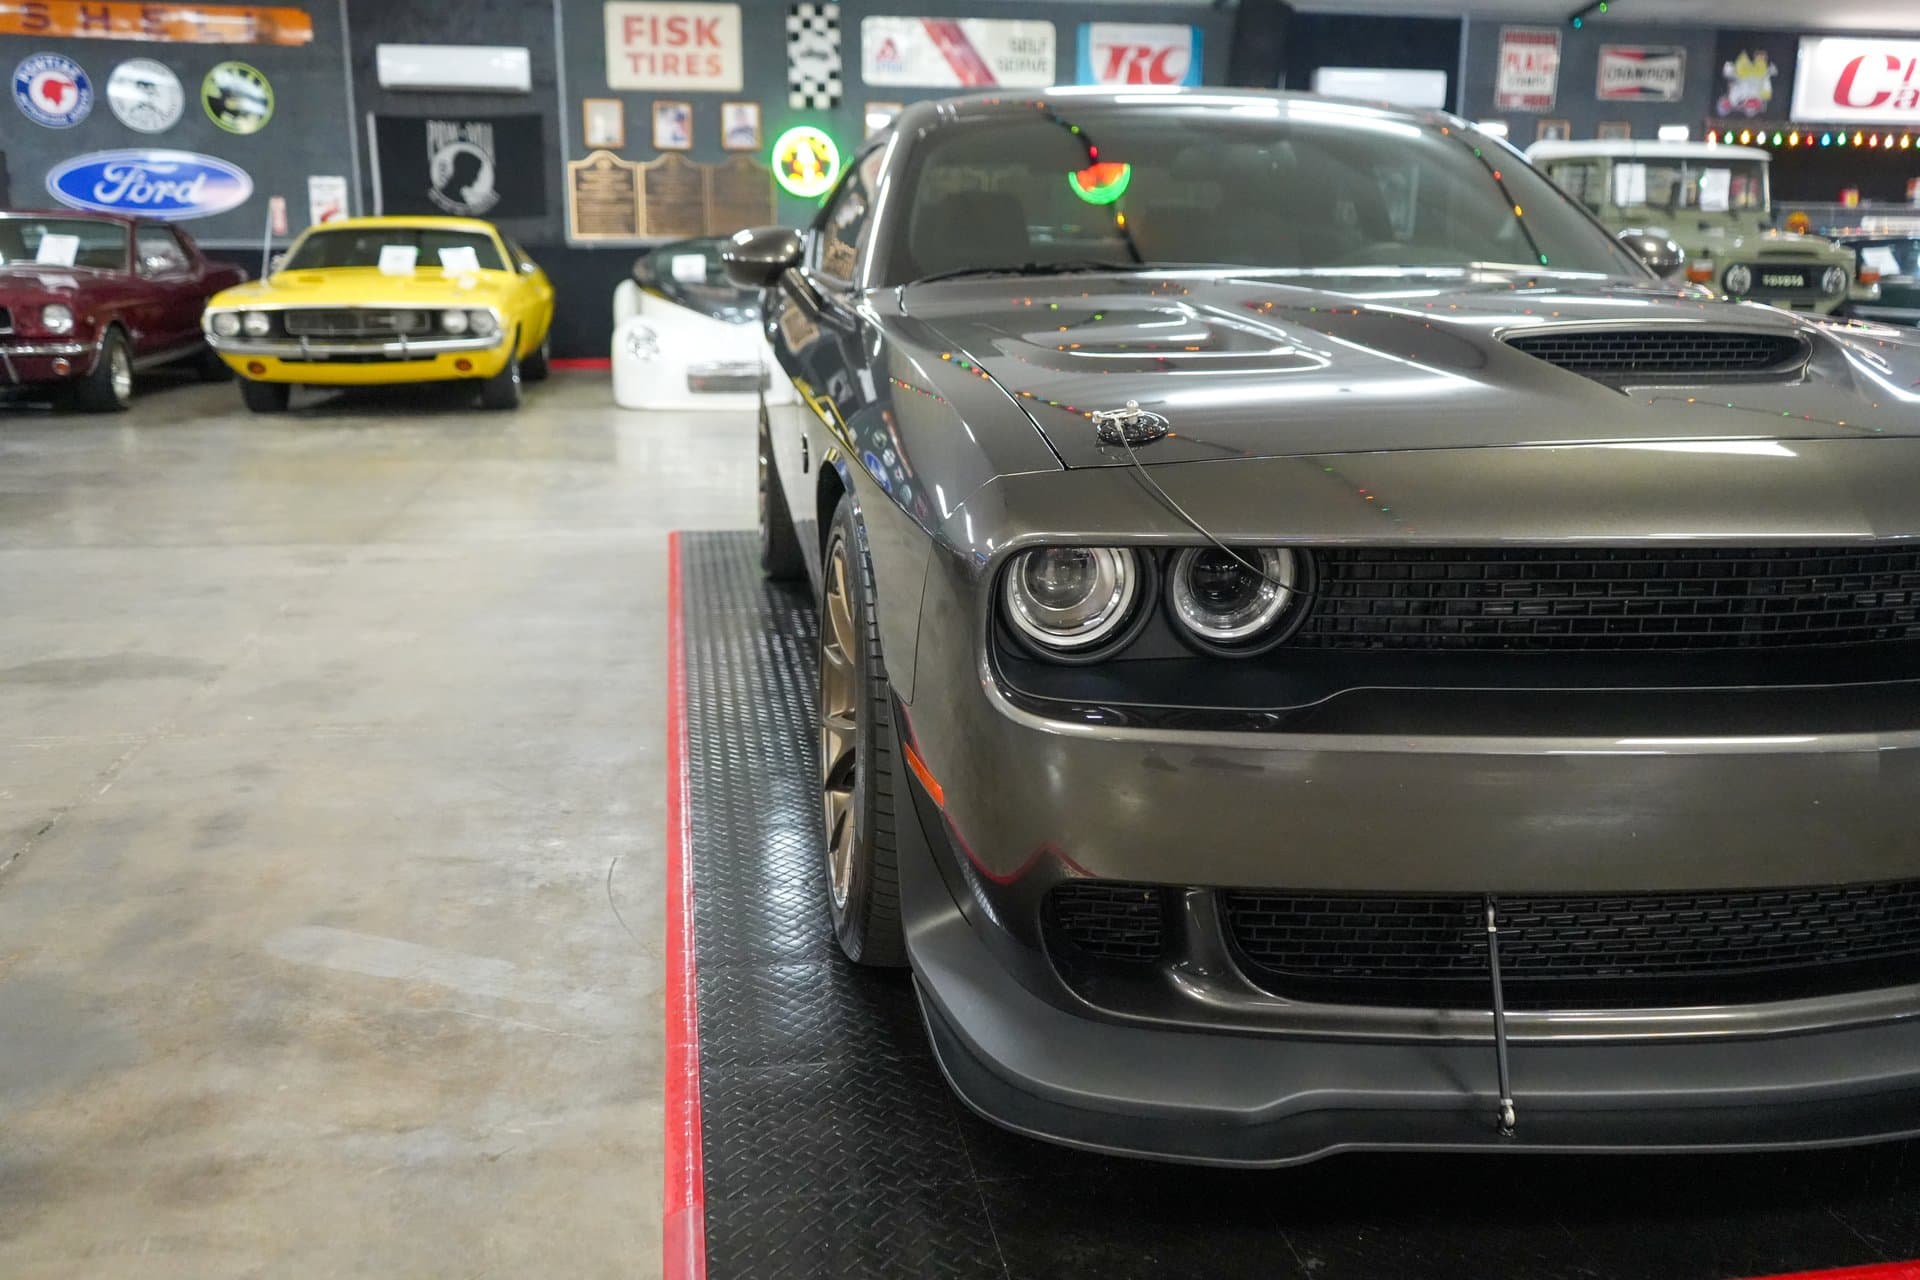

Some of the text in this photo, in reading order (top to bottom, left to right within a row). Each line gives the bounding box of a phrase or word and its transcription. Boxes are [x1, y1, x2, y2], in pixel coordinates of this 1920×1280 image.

[623, 15, 722, 47] FISK
[625, 52, 723, 77] TIRES
[93, 161, 208, 204] Ford
[1762, 274, 1804, 287] TOYOTA
